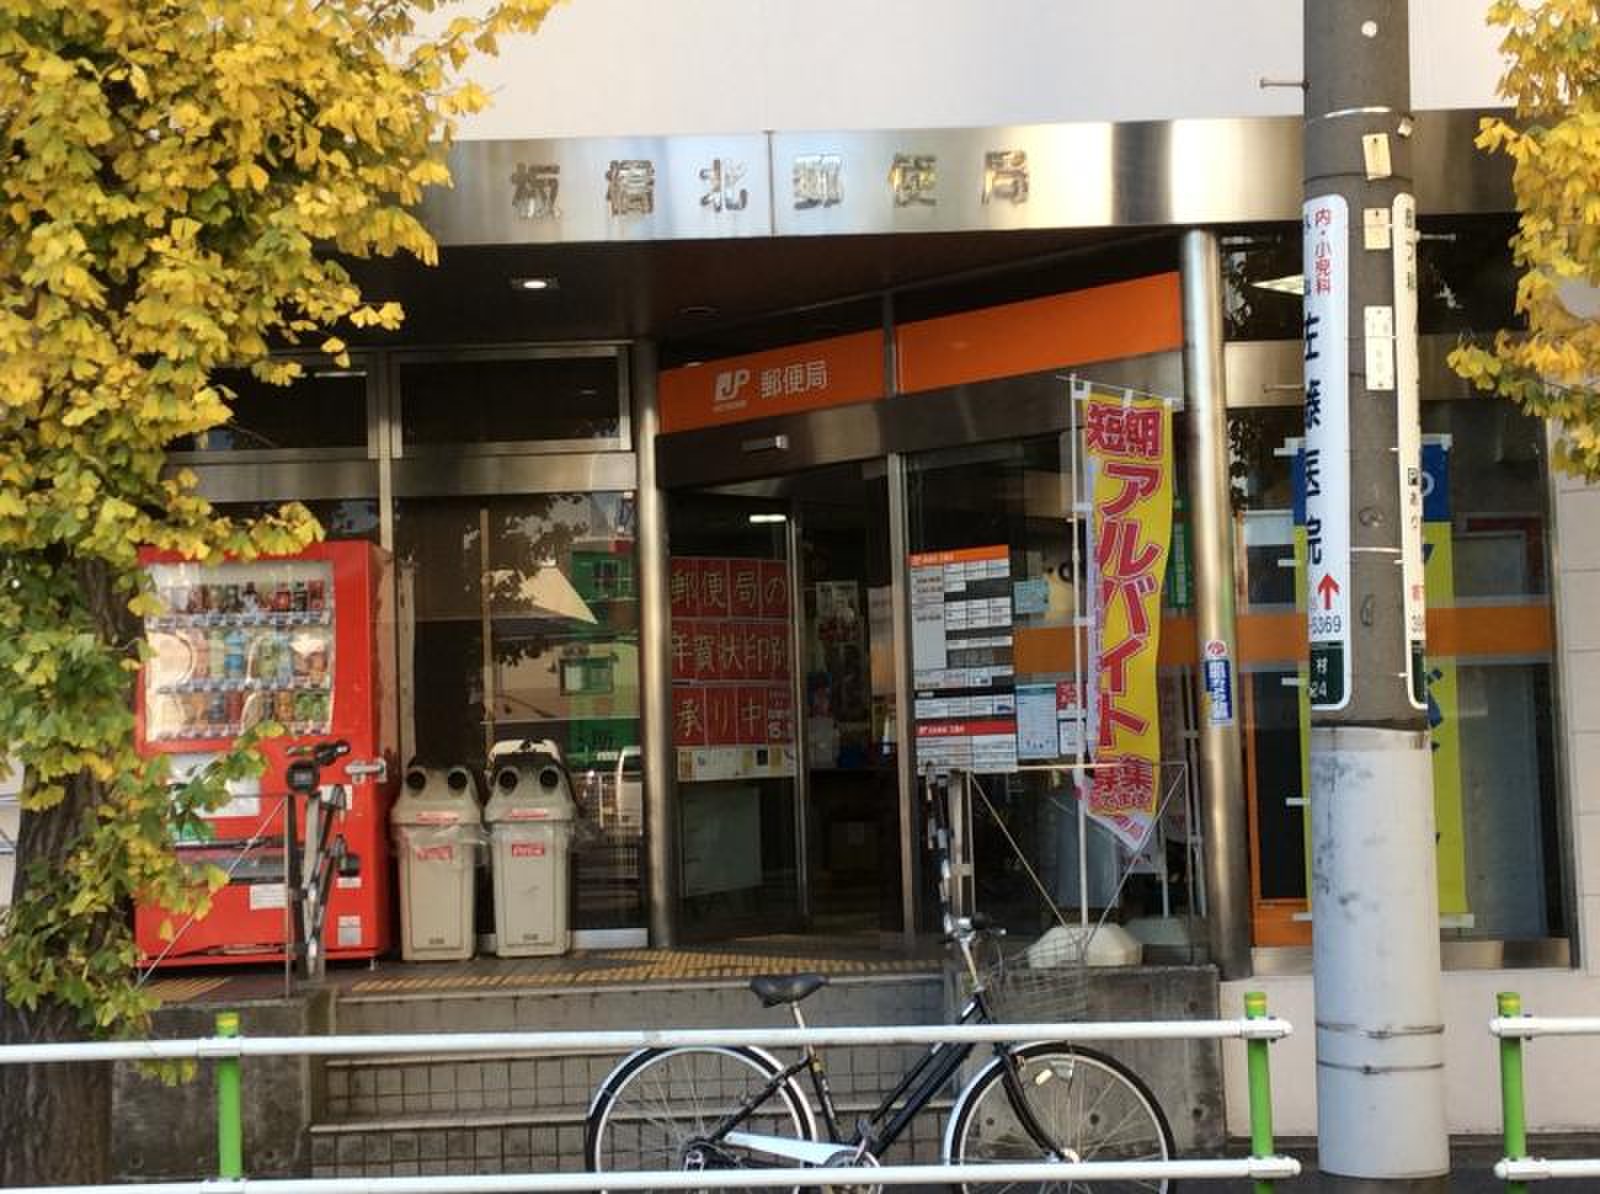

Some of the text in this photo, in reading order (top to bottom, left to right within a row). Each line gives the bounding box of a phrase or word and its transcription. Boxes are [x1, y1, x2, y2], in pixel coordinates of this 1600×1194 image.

[511, 150, 1031, 220] 板橋北郵便局
[760, 360, 827, 398] 郵便局
[671, 569, 788, 611] 郵便局の
[1096, 462, 1163, 750] アルバイト
[676, 697, 764, 738] 承り中
